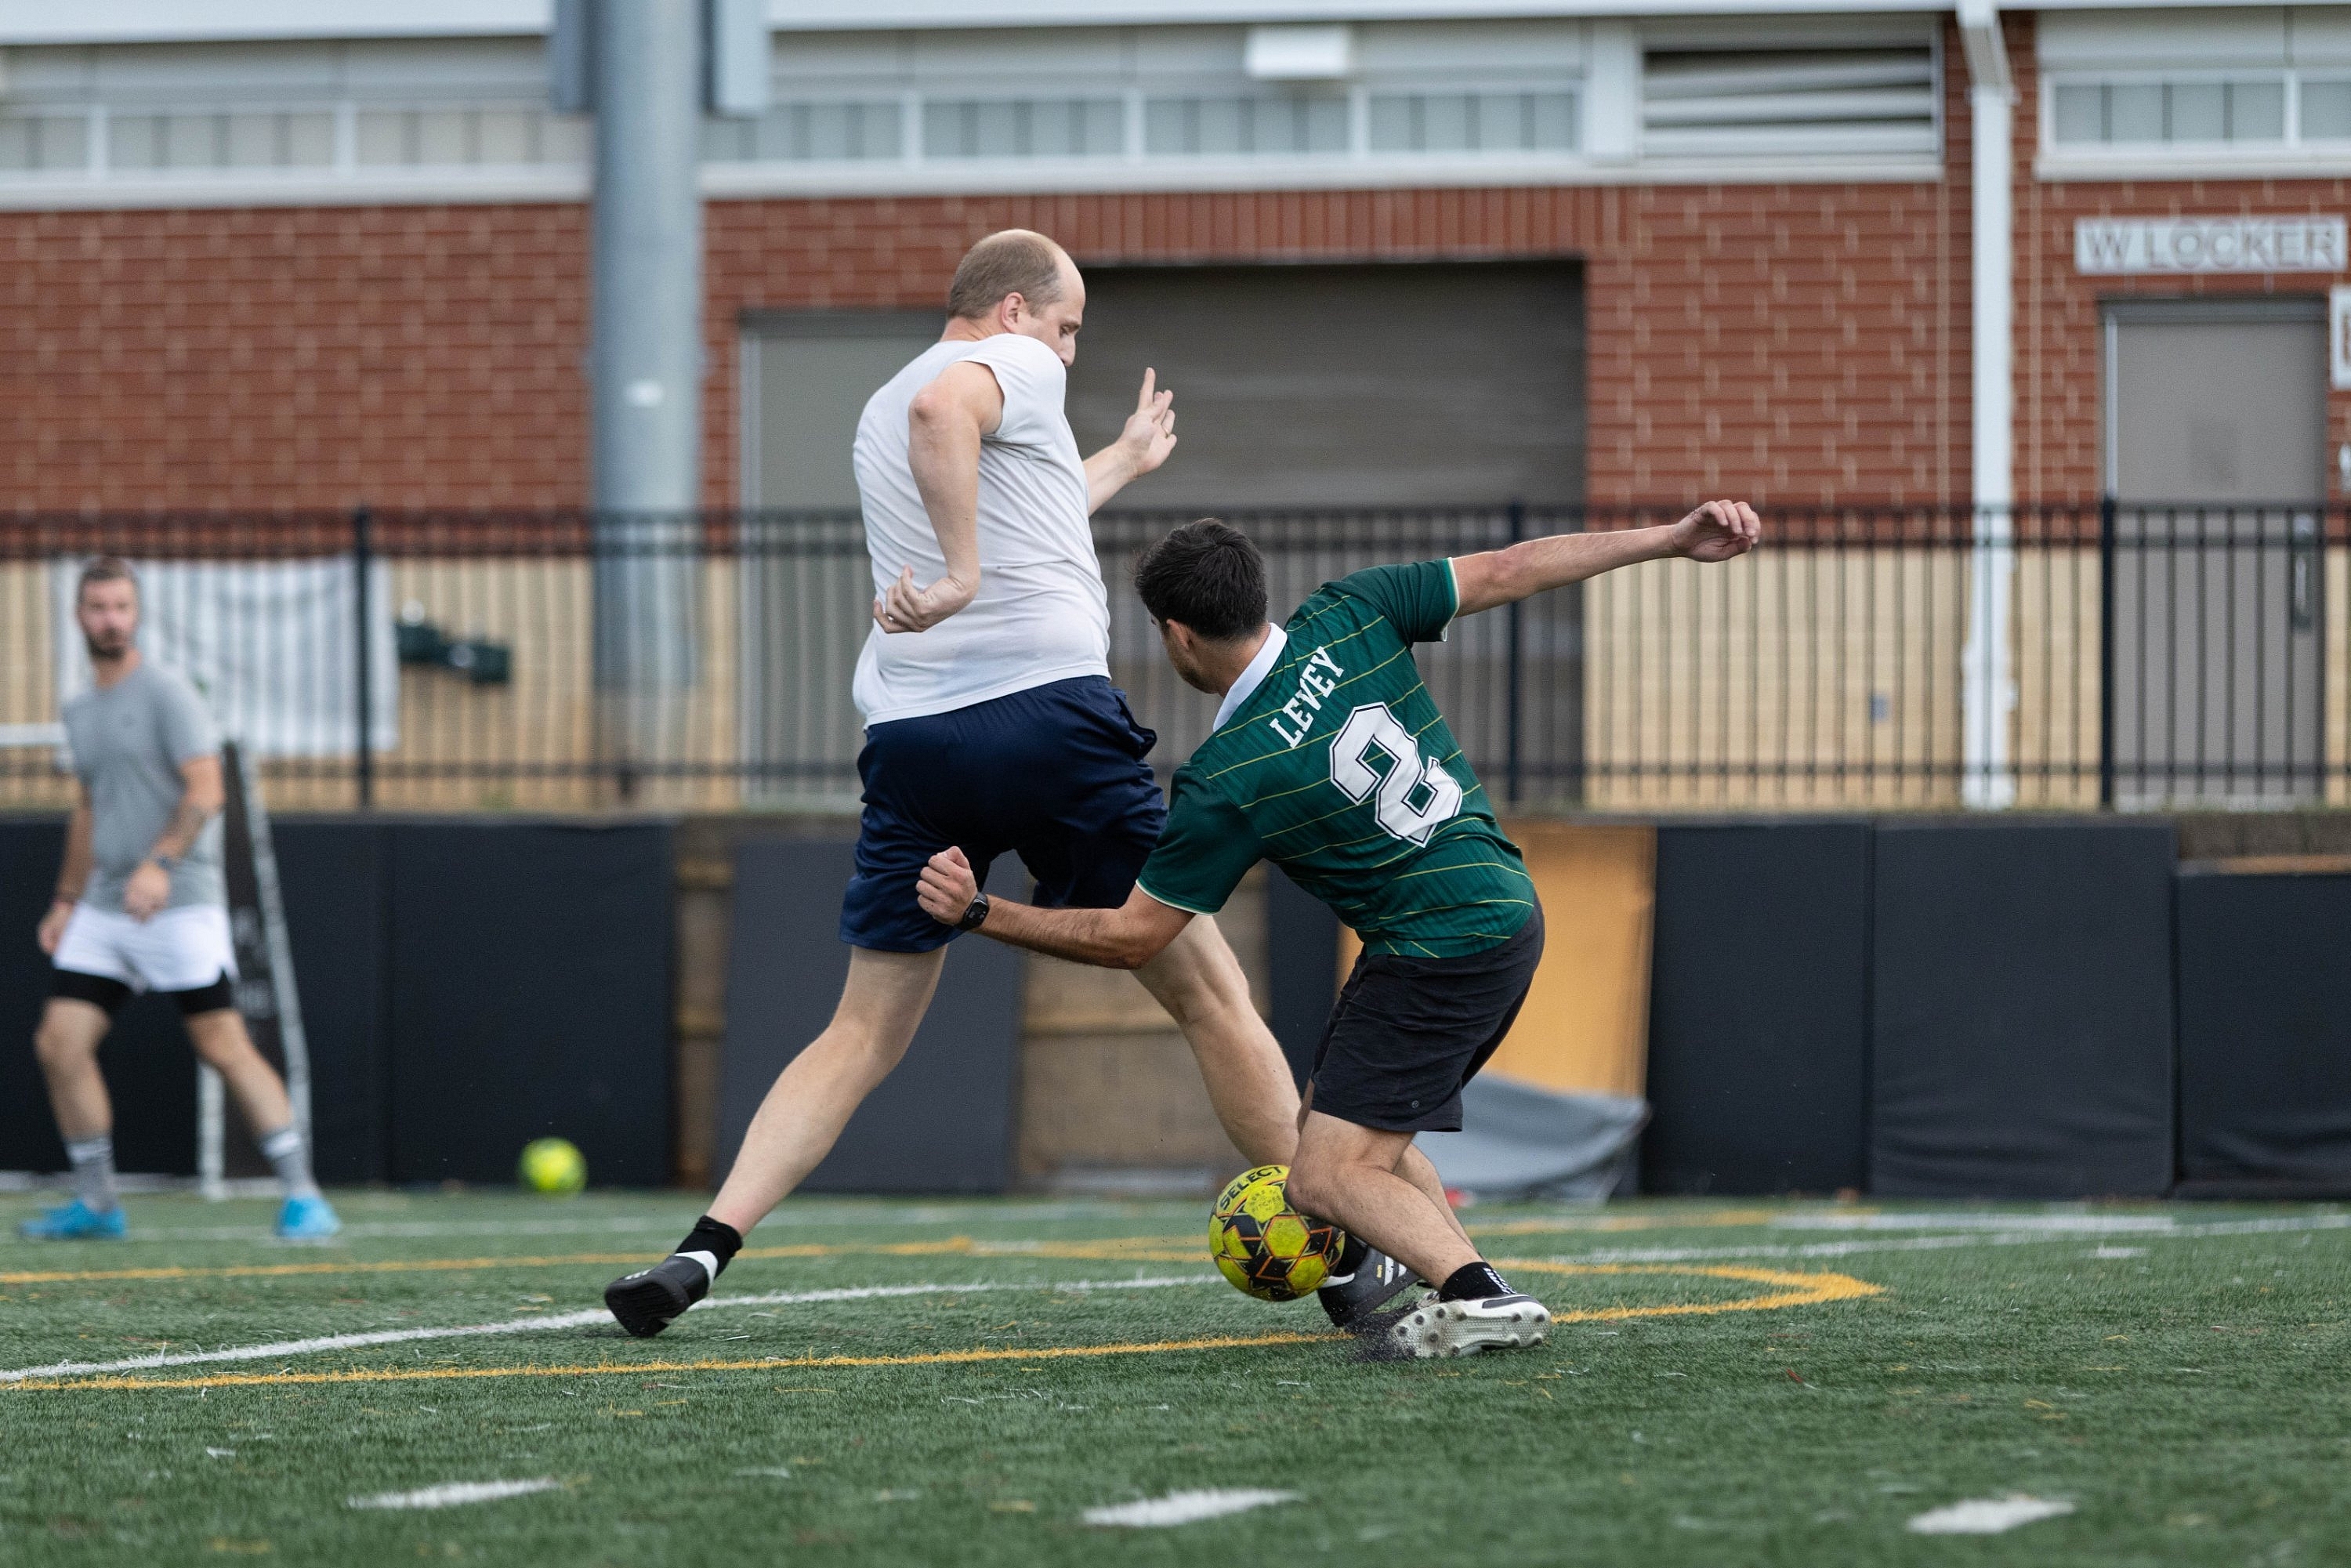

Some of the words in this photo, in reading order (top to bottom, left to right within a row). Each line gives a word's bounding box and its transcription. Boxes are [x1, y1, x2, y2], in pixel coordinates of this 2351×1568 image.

[2081, 223, 2132, 267] W
[2144, 222, 2338, 267] LOCKER
[1270, 646, 1344, 748] LEVEY
[1329, 701, 1463, 848] 2
[1220, 1166, 1282, 1211] SELECT
